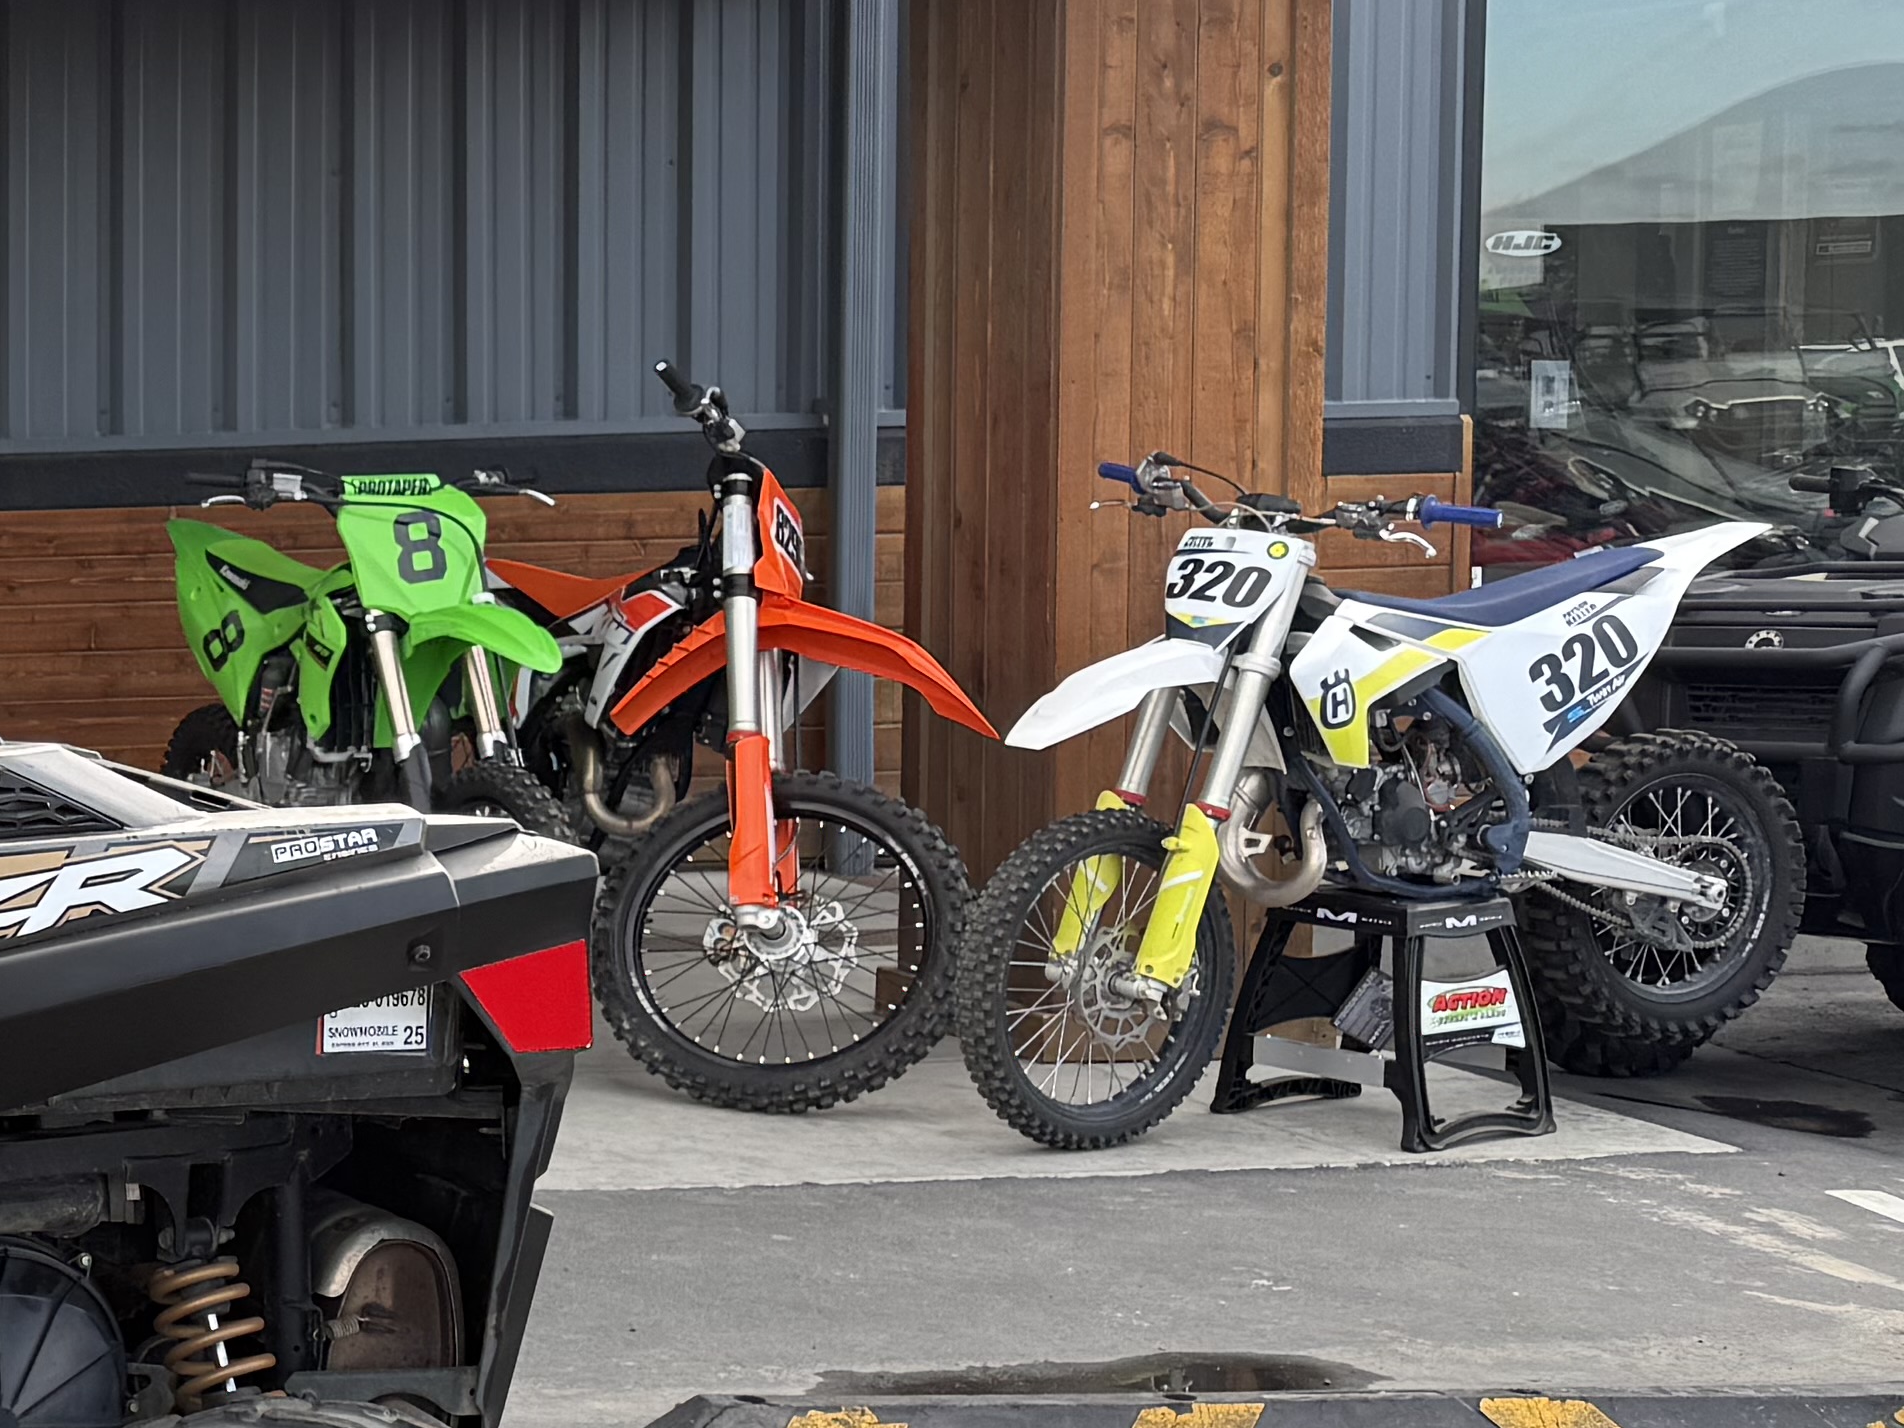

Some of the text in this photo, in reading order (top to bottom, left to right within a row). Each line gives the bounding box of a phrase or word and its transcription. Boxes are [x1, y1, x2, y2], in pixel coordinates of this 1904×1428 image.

[1491, 235, 1555, 251] HJC
[394, 512, 447, 585] 8
[1166, 558, 1272, 608] 320
[1529, 615, 1638, 712] 320
[1433, 987, 1507, 1013] ACTION
[403, 1025, 424, 1045] 25
